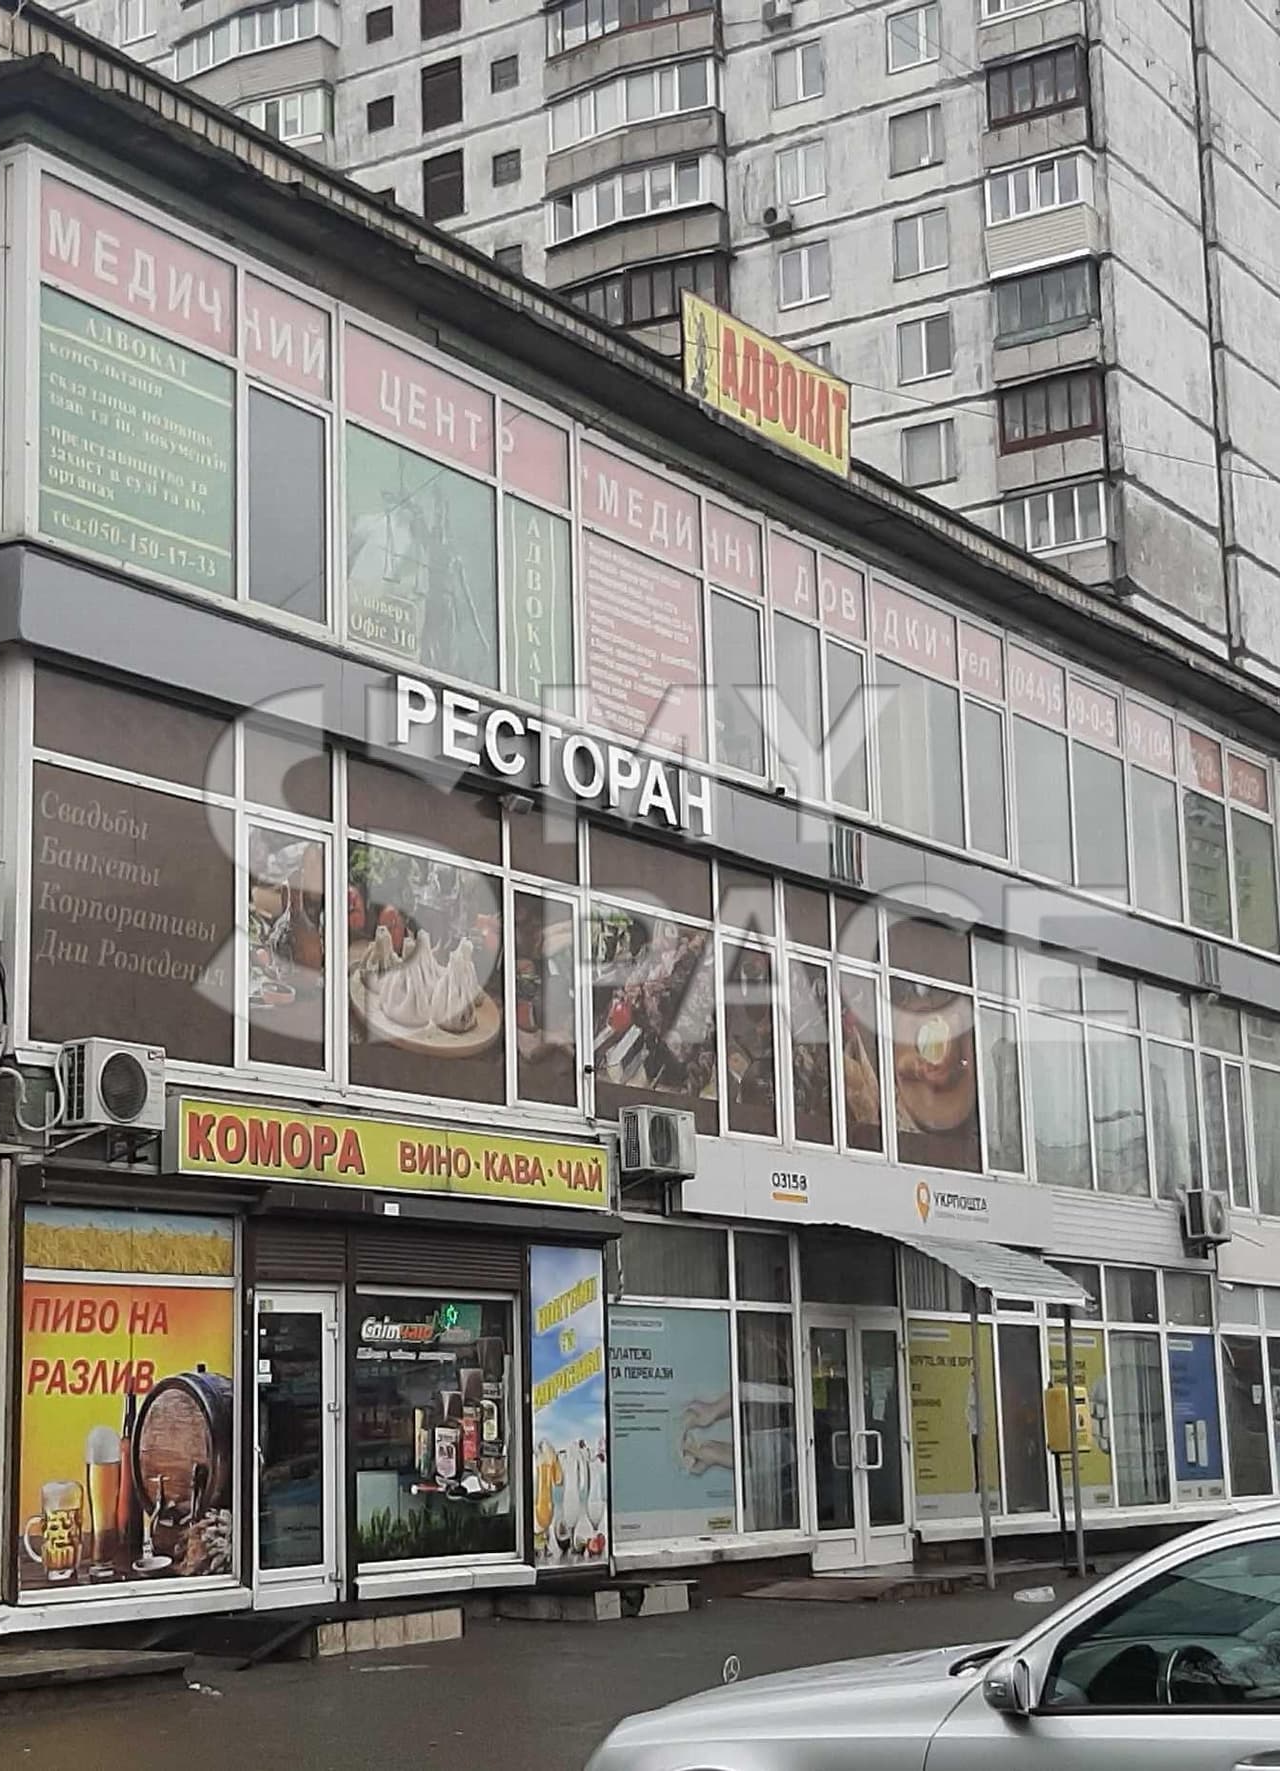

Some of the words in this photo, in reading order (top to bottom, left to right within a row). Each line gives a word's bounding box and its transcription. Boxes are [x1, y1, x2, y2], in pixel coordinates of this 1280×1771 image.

[86, 318, 188, 377] АДВОКАТ
[722, 326, 848, 461] АДВОКАТ
[392, 674, 712, 836] РЕСТОРАН
[40, 789, 151, 842] Свадьбы
[39, 836, 161, 887] Банкеты
[37, 881, 216, 943] Корпоративы
[36, 928, 89, 964] Дни
[97, 943, 226, 987] Рождения
[187, 1111, 367, 1175] КОМОРА
[399, 1140, 471, 1179] ВИНО
[482, 1151, 546, 1187] КАВА
[557, 1156, 604, 1193] ЧАЙ
[933, 1192, 988, 1211] УКРПОШТА
[27, 1297, 120, 1335] ПИВО
[128, 1301, 169, 1336] НА
[26, 1359, 156, 1396] РАЗЛИВ
